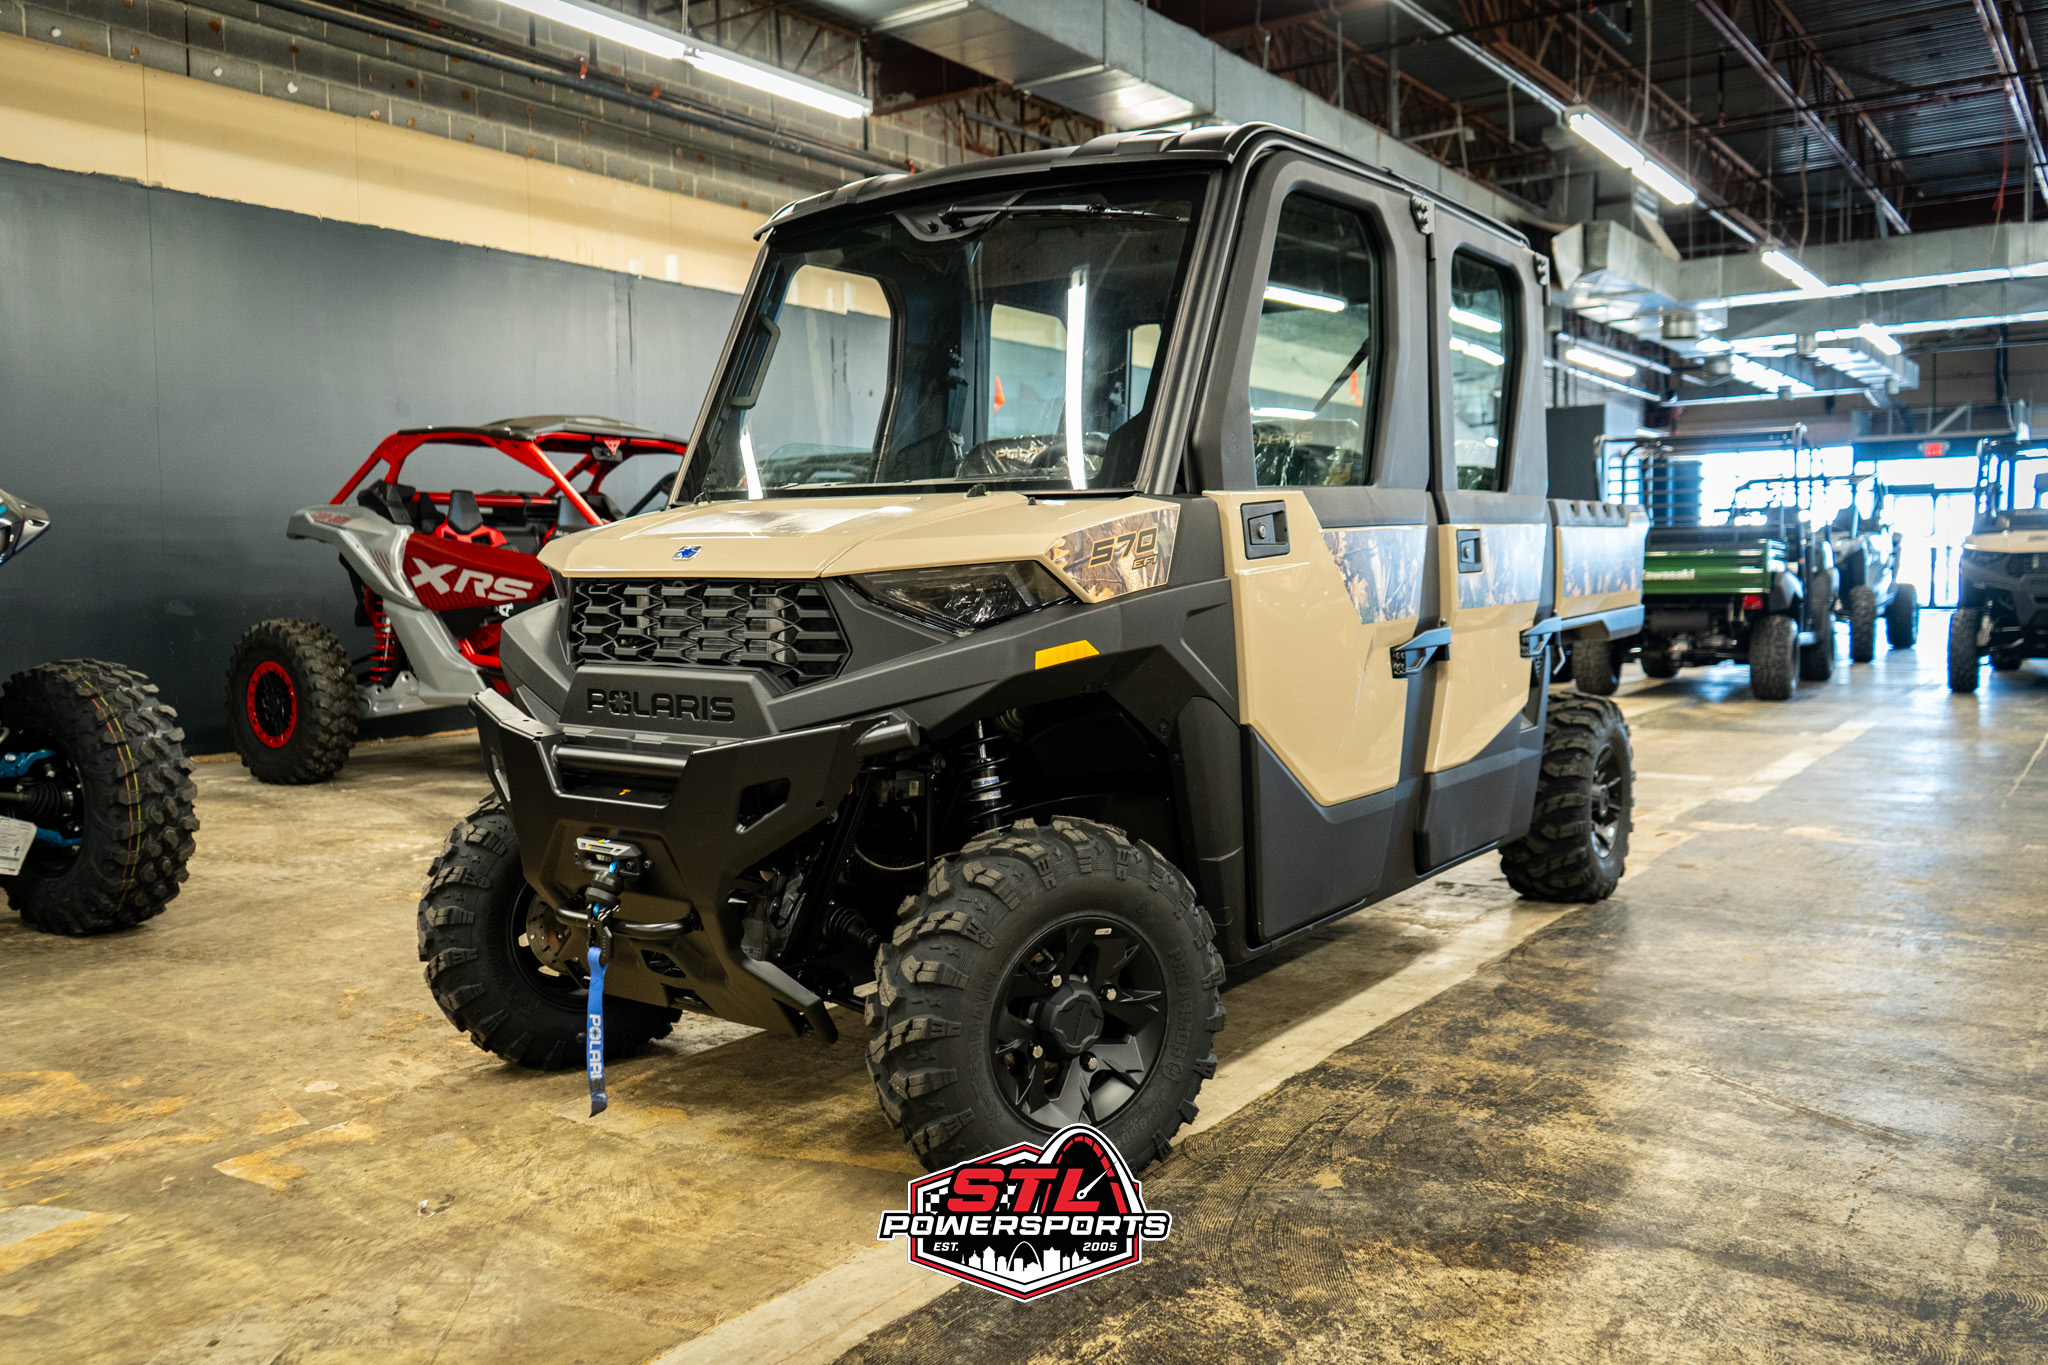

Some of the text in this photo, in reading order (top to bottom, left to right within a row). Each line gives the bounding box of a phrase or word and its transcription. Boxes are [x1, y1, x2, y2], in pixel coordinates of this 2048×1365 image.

[1087, 526, 1159, 569] 570
[1132, 553, 1159, 570] EFI
[411, 557, 534, 601] XRS
[587, 688, 736, 724] POLARIS
[588, 1013, 603, 1080] POLARI
